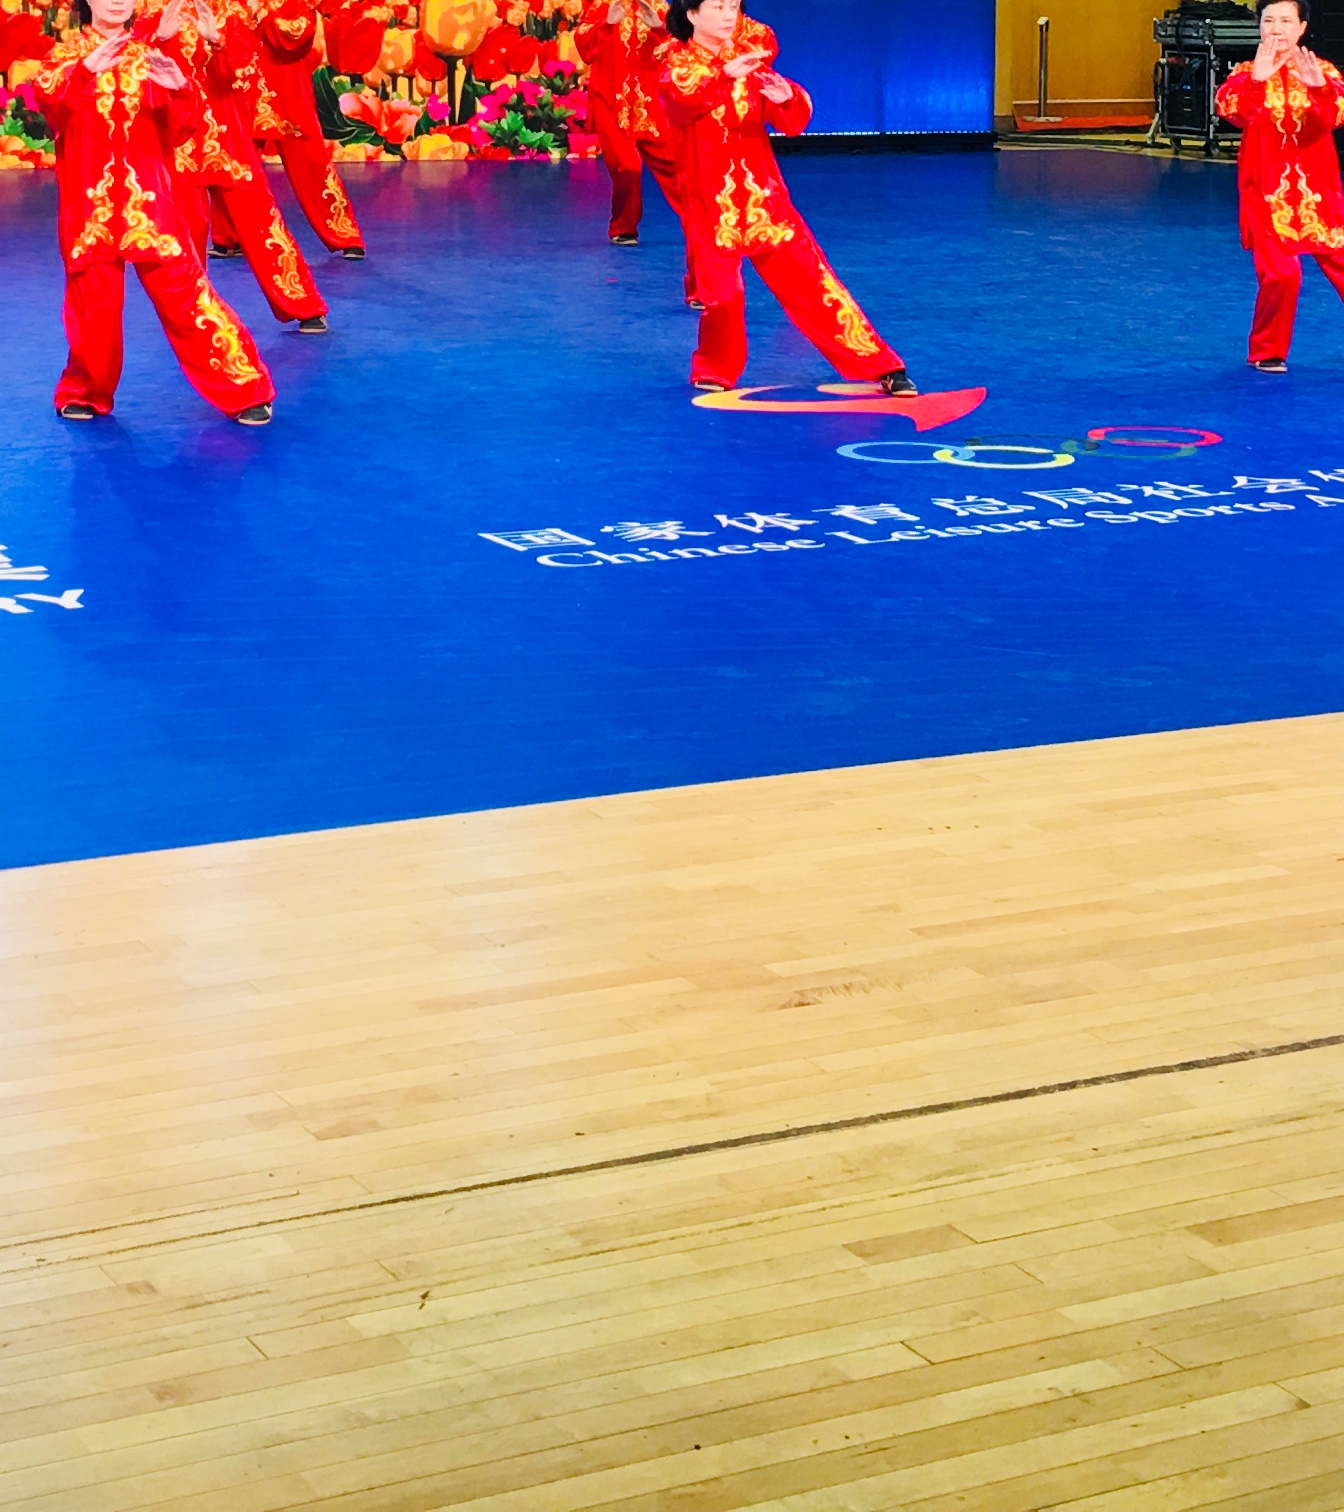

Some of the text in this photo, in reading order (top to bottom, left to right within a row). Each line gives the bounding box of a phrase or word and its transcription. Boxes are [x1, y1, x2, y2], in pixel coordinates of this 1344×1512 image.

[536, 535, 826, 568] Chinese
[825, 515, 1086, 545] Leisure
[1085, 500, 1296, 524] Sports
